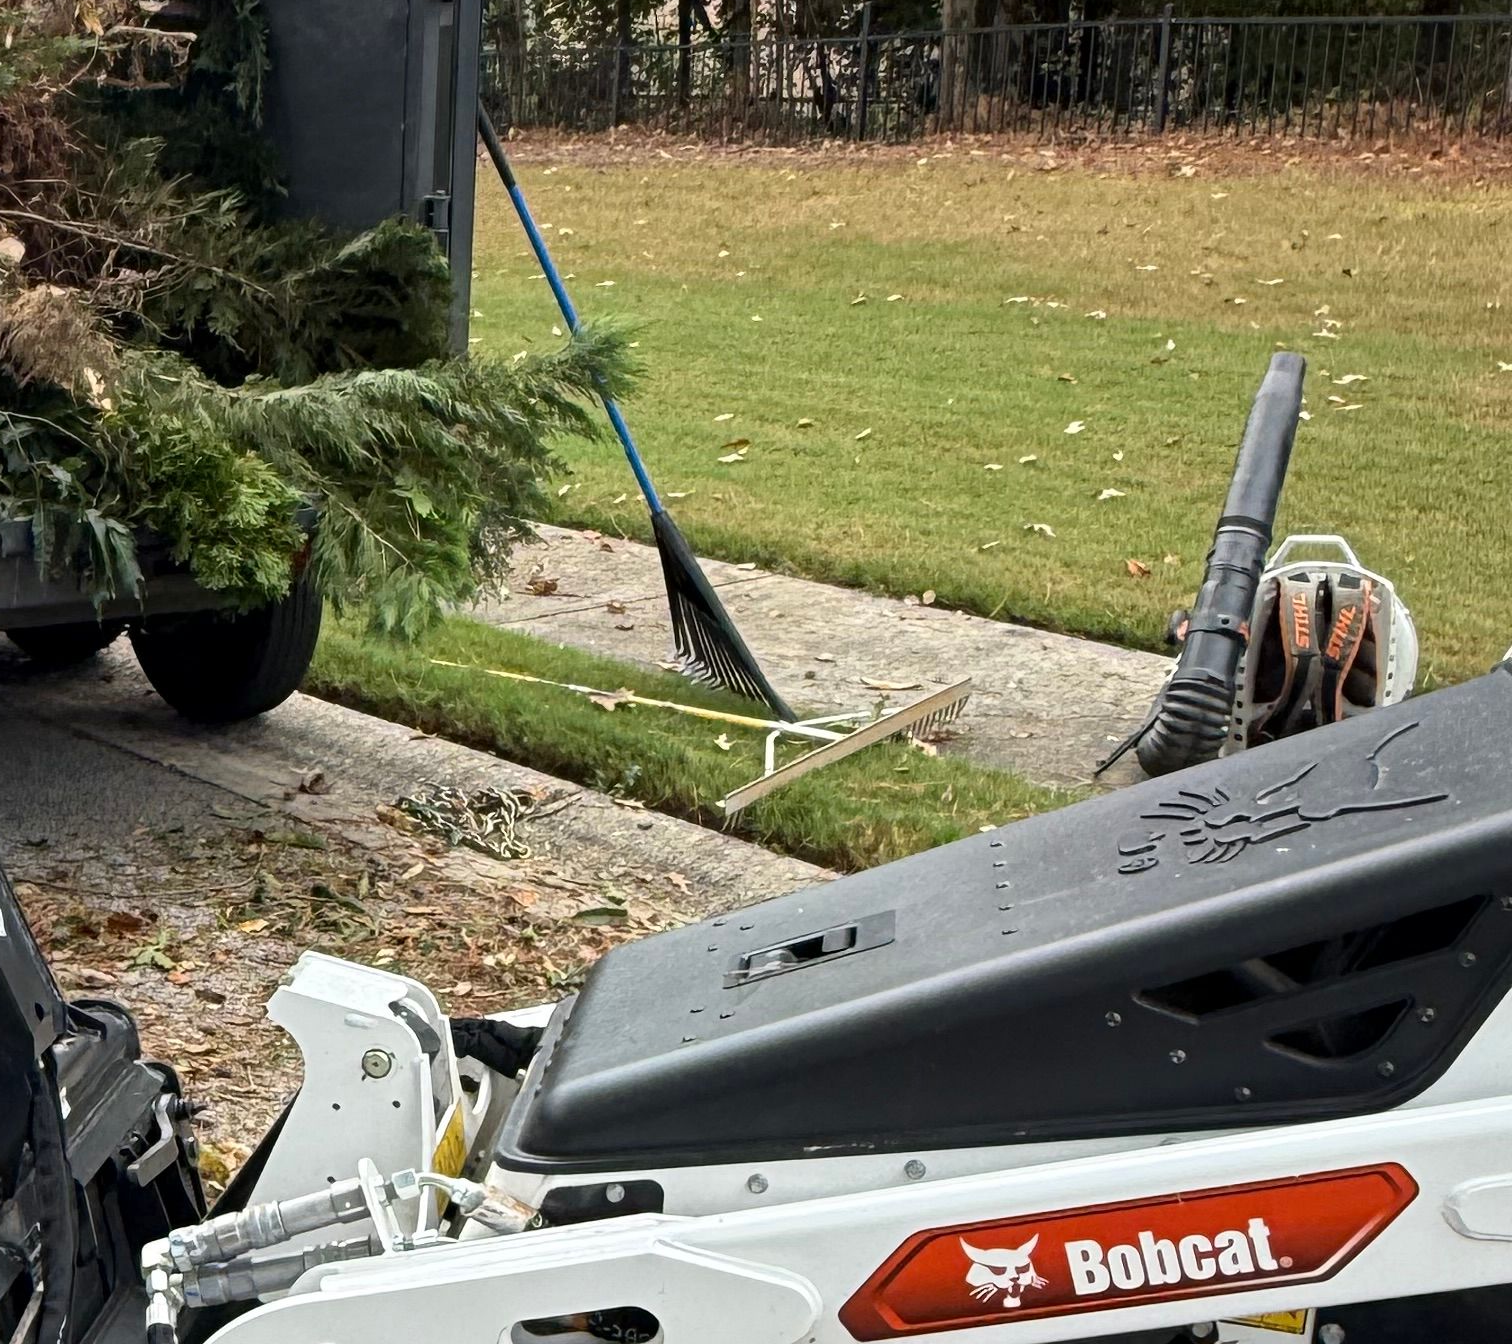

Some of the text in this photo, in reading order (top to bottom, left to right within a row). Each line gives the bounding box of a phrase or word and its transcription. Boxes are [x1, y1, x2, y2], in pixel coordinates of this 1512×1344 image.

[1292, 593, 1309, 648] STIHL
[1326, 606, 1356, 661] STIHL
[1064, 1217, 1280, 1296] Bobcat
